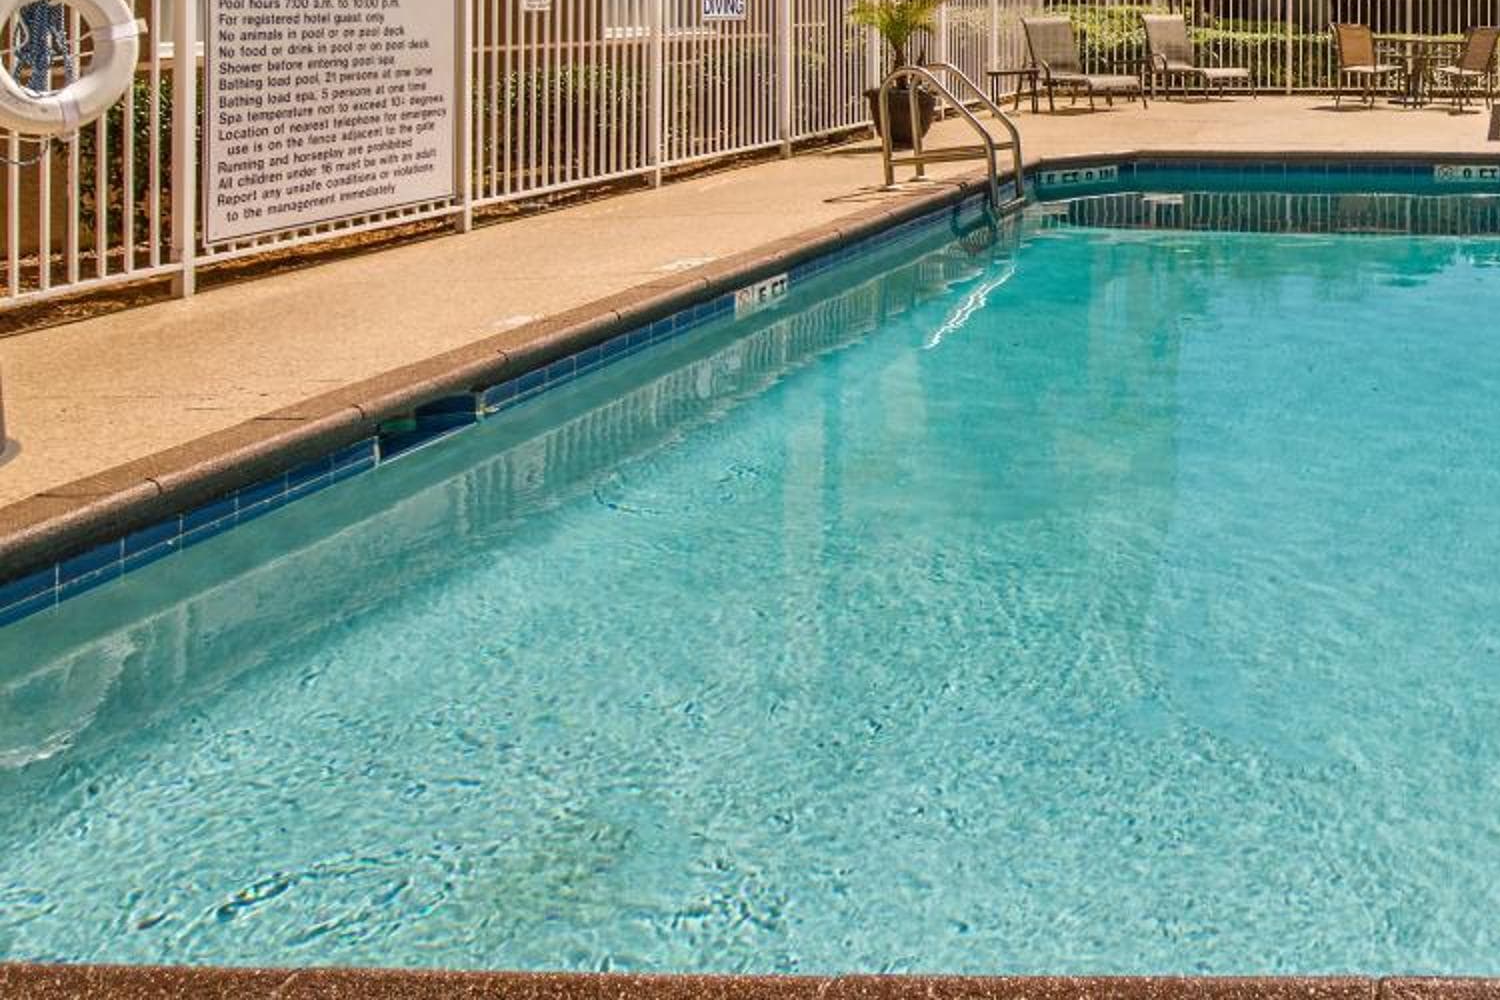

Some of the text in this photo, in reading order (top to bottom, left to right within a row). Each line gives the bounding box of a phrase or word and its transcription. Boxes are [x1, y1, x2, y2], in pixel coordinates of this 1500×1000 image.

[338, 0, 348, 8] to
[219, 14, 237, 25] For
[242, 13, 300, 27] registered
[303, 13, 330, 25] hotel
[366, 13, 384, 25] only
[219, 30, 235, 41] No
[240, 29, 282, 41] animals
[288, 28, 297, 39] in
[302, 28, 324, 41] pool
[328, 29, 338, 38] or
[383, 26, 404, 37] deck
[219, 46, 235, 58] No
[240, 45, 266, 57] food
[272, 47, 282, 56] or
[288, 44, 313, 55] drink
[318, 42, 327, 53] in
[331, 42, 352, 54] pool
[357, 43, 366, 52] or
[370, 42, 382, 51] on
[386, 41, 405, 51] pool
[219, 62, 262, 75] Shower
[267, 60, 303, 71] before
[308, 57, 348, 70] entering
[219, 77, 262, 91] Bathing
[267, 75, 291, 87] load
[339, 70, 378, 83] persons
[382, 68, 391, 78] at
[219, 94, 262, 109] Bathing
[267, 92, 291, 104] load
[331, 87, 371, 100] persons
[375, 85, 384, 95] at
[219, 111, 242, 125] Spa
[247, 106, 313, 122] temperature
[318, 103, 335, 115] not
[338, 102, 349, 113] to
[353, 98, 387, 112] exceed
[218, 126, 269, 141] Location
[273, 122, 285, 135] of
[289, 118, 329, 134] nearest
[333, 114, 380, 130] telephone
[384, 111, 397, 123] for
[228, 143, 249, 156] use
[253, 141, 263, 153] is
[268, 140, 282, 151] on
[287, 136, 304, 149] the
[341, 126, 383, 142] adjacent
[218, 159, 265, 174] Running
[269, 154, 289, 168] and
[294, 147, 343, 164] horseplay
[347, 145, 363, 157] are
[219, 176, 233, 190] All
[237, 171, 283, 188] children
[286, 166, 317, 181] under
[335, 158, 361, 172] must
[364, 158, 376, 168] be
[217, 189, 257, 206] Report
[261, 187, 282, 201] any
[286, 179, 322, 196] unsafe
[379, 170, 389, 180] or
[226, 180, 396, 223] to the management immediately
